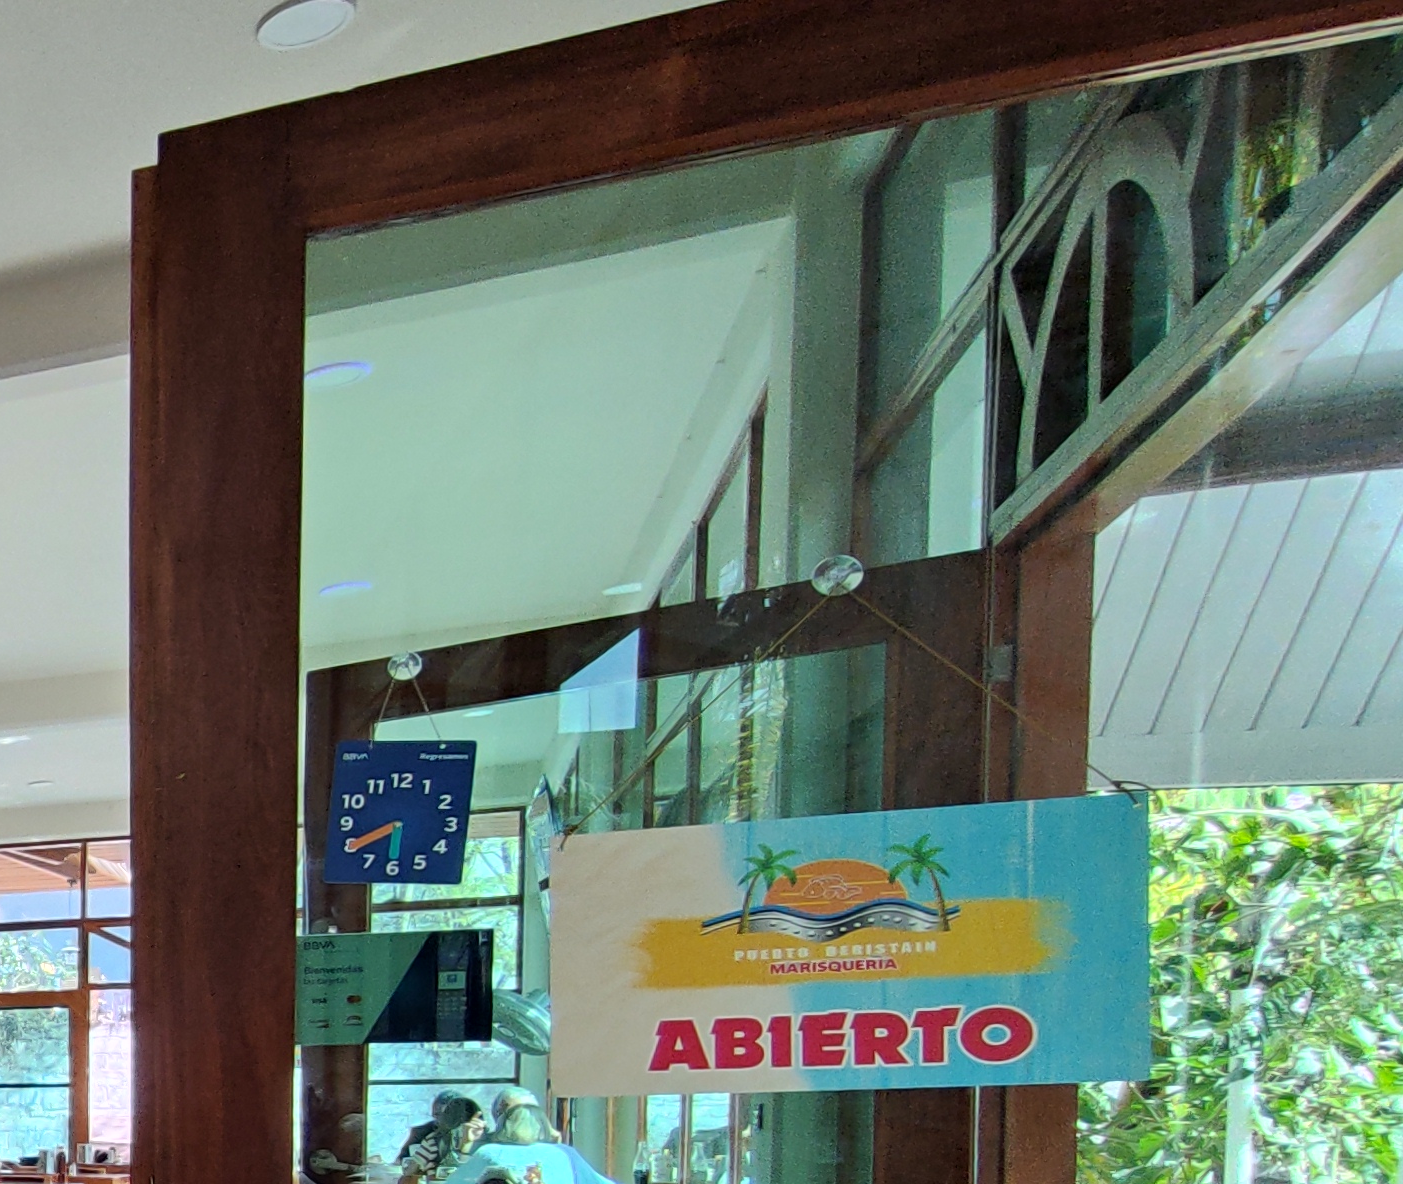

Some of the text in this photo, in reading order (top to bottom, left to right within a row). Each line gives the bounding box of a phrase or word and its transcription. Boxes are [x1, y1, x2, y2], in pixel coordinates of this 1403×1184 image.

[342, 753, 369, 761] BBVA
[366, 779, 385, 794] 11
[390, 773, 413, 788] 12
[422, 779, 432, 794] 1
[341, 794, 365, 809] 10
[437, 794, 452, 809] 2
[340, 816, 354, 831] 9
[443, 817, 458, 832] 3
[432, 839, 448, 854] 4
[362, 854, 376, 869] 7
[385, 861, 399, 876] 6
[412, 854, 427, 870] 5
[303, 941, 335, 950] BBVA
[734, 940, 937, 961] PUERTO BERISTAIN
[770, 958, 897, 975] MARISQUERIA
[647, 1006, 1035, 1072] ABIERTO
